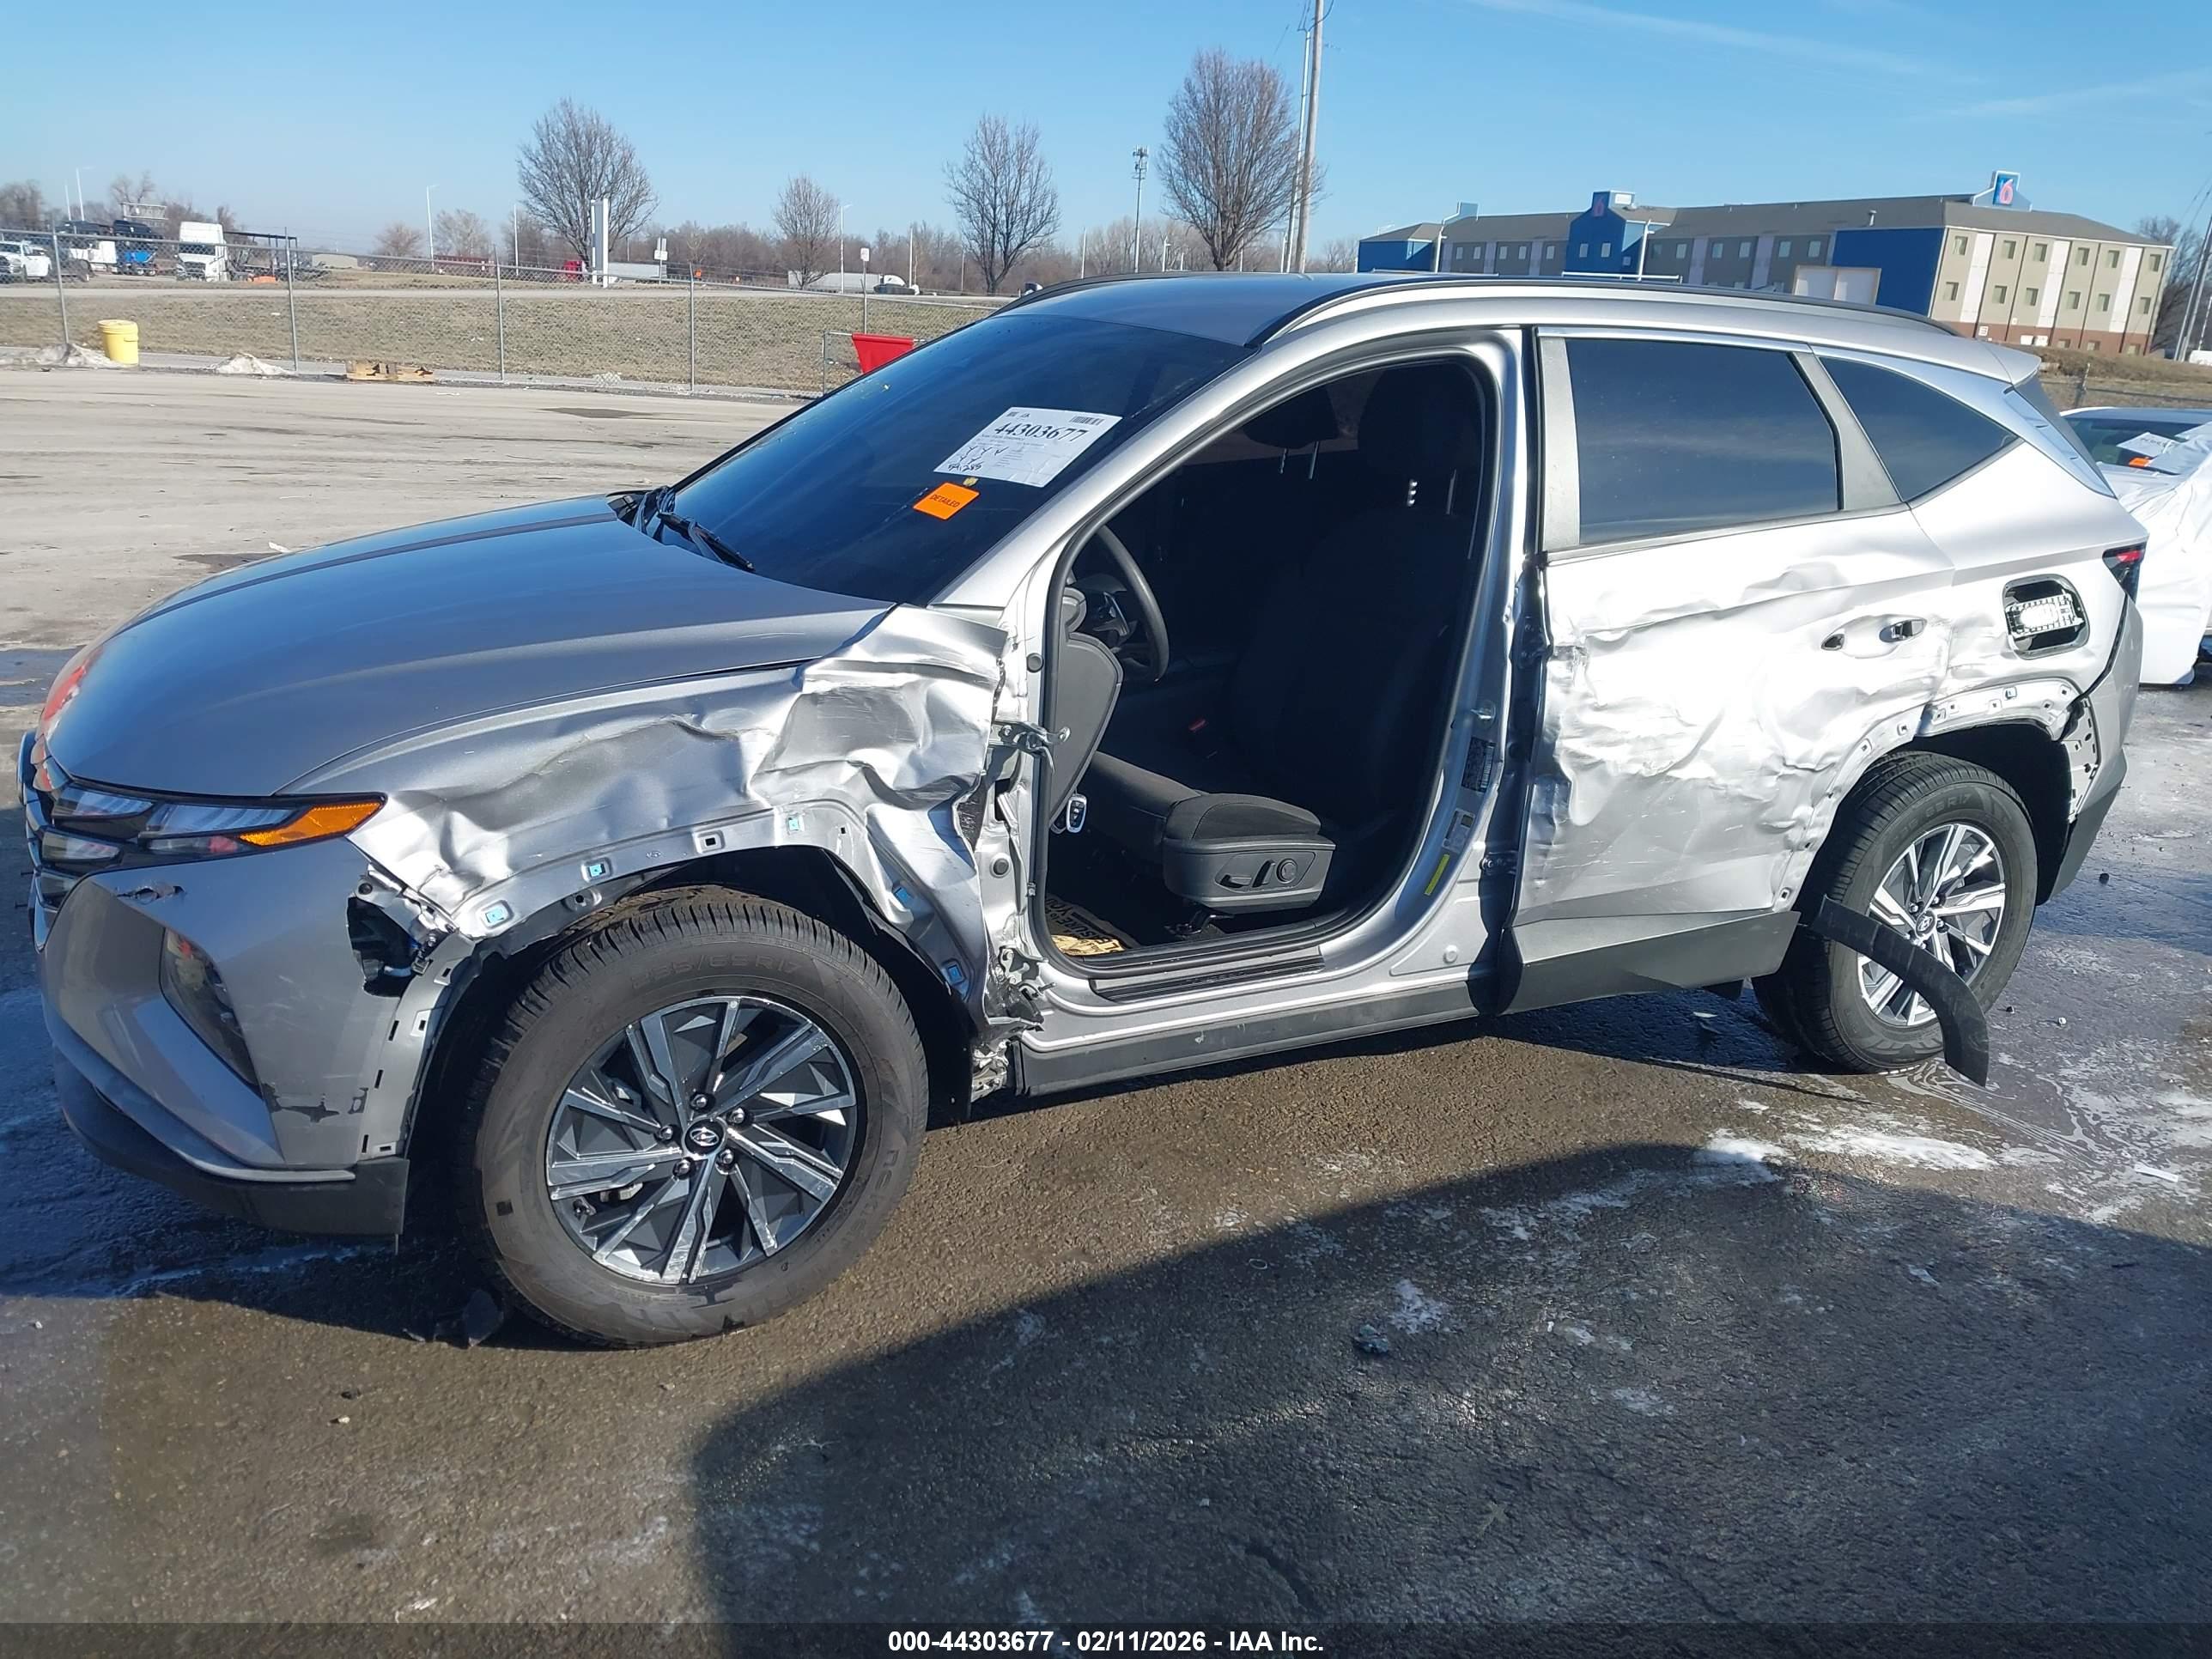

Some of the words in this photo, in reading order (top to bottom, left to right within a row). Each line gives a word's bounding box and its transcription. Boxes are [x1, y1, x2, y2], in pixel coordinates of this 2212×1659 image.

[1999, 178, 2014, 205] 6
[994, 422, 1089, 442] 44303677
[930, 494, 961, 507] DETAILED
